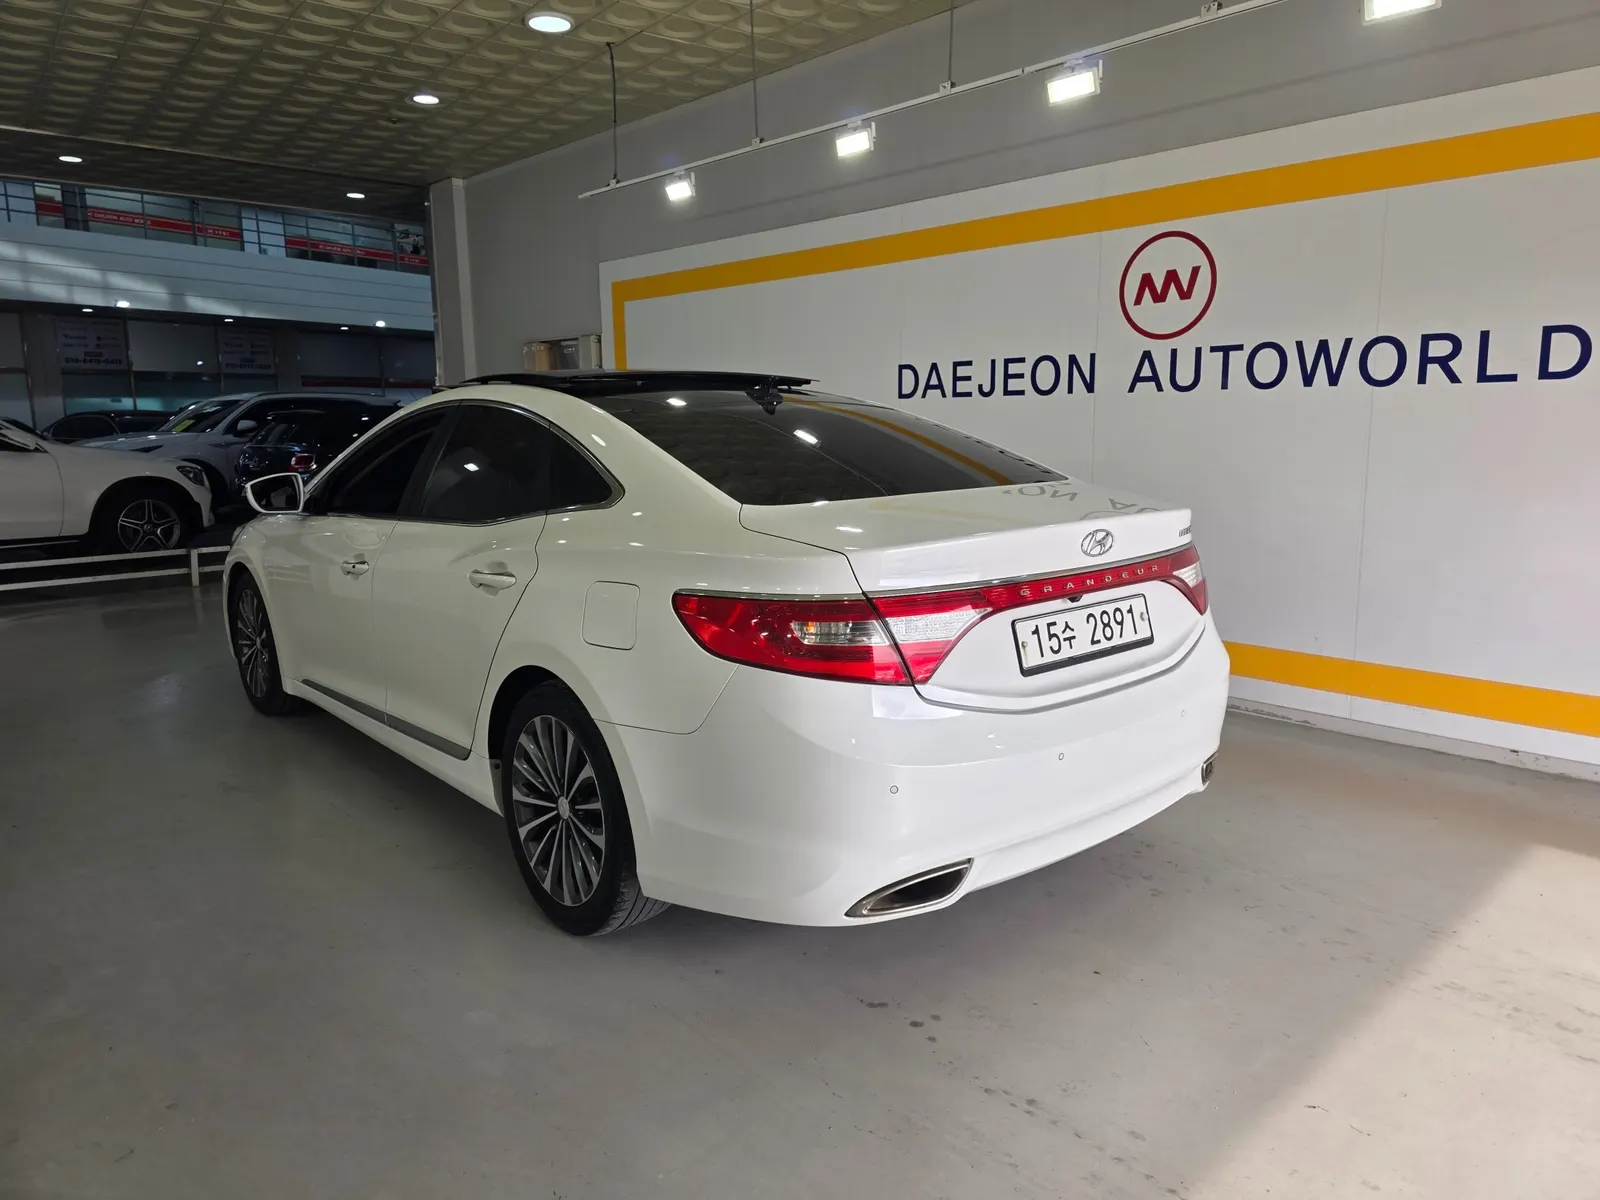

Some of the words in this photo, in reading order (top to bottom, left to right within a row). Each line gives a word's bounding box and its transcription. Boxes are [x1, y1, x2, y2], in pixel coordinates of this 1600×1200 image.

[897, 352, 1096, 400] DAEJEON
[1127, 324, 1593, 393] AUTOWORLD
[1020, 565, 1159, 596] GRANDEUR
[1031, 621, 1077, 658] 15수
[1086, 604, 1138, 646] 2891
